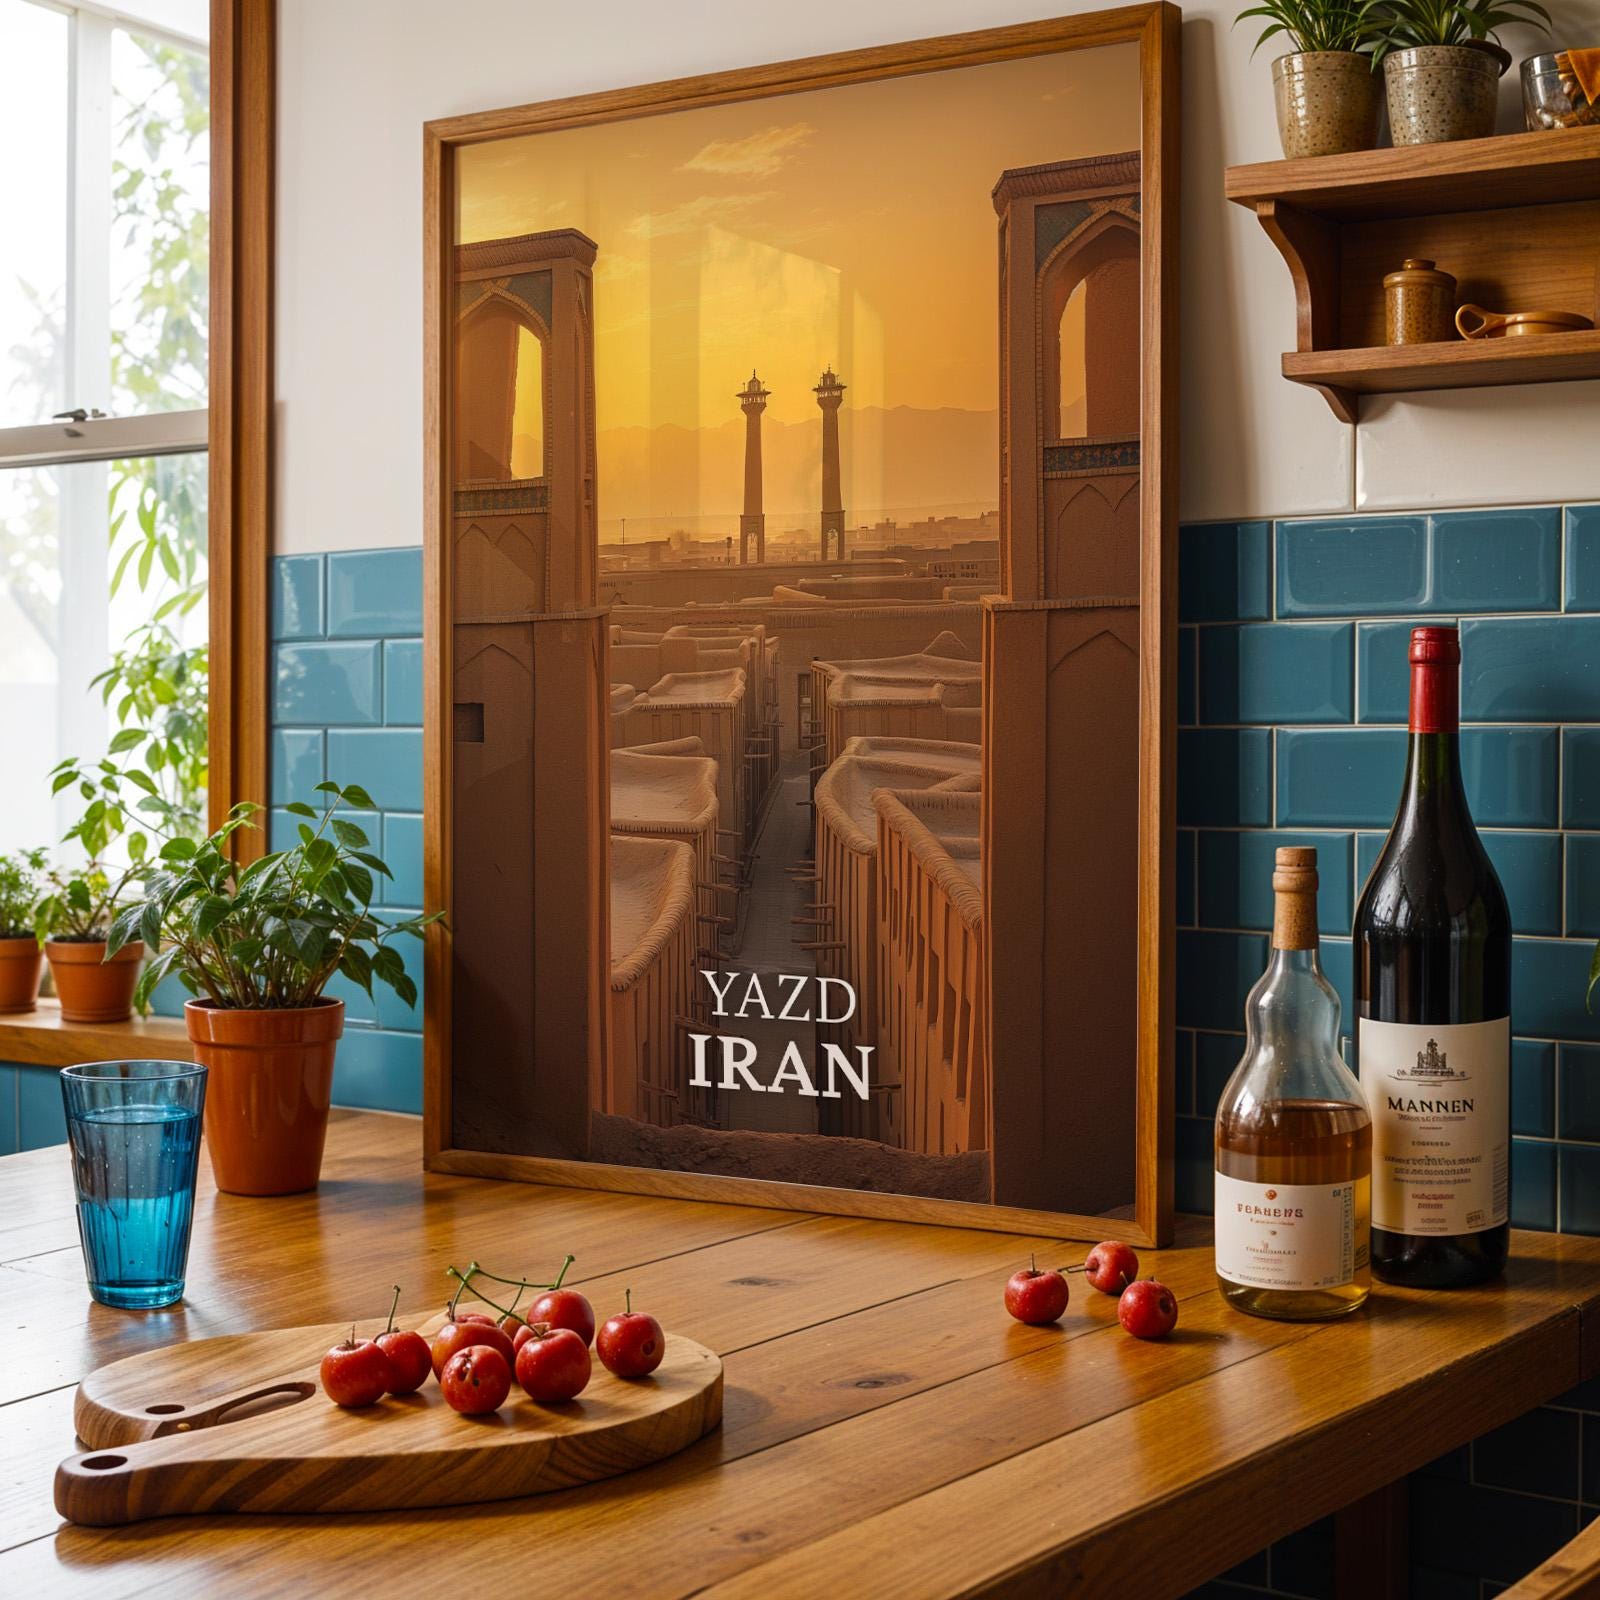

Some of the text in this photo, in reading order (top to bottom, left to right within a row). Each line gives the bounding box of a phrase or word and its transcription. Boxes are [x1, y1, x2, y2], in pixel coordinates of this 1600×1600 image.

[699, 970, 857, 1024] YAZD
[687, 1033, 876, 1101] IRAN
[1387, 1096, 1475, 1113] MANNEN
